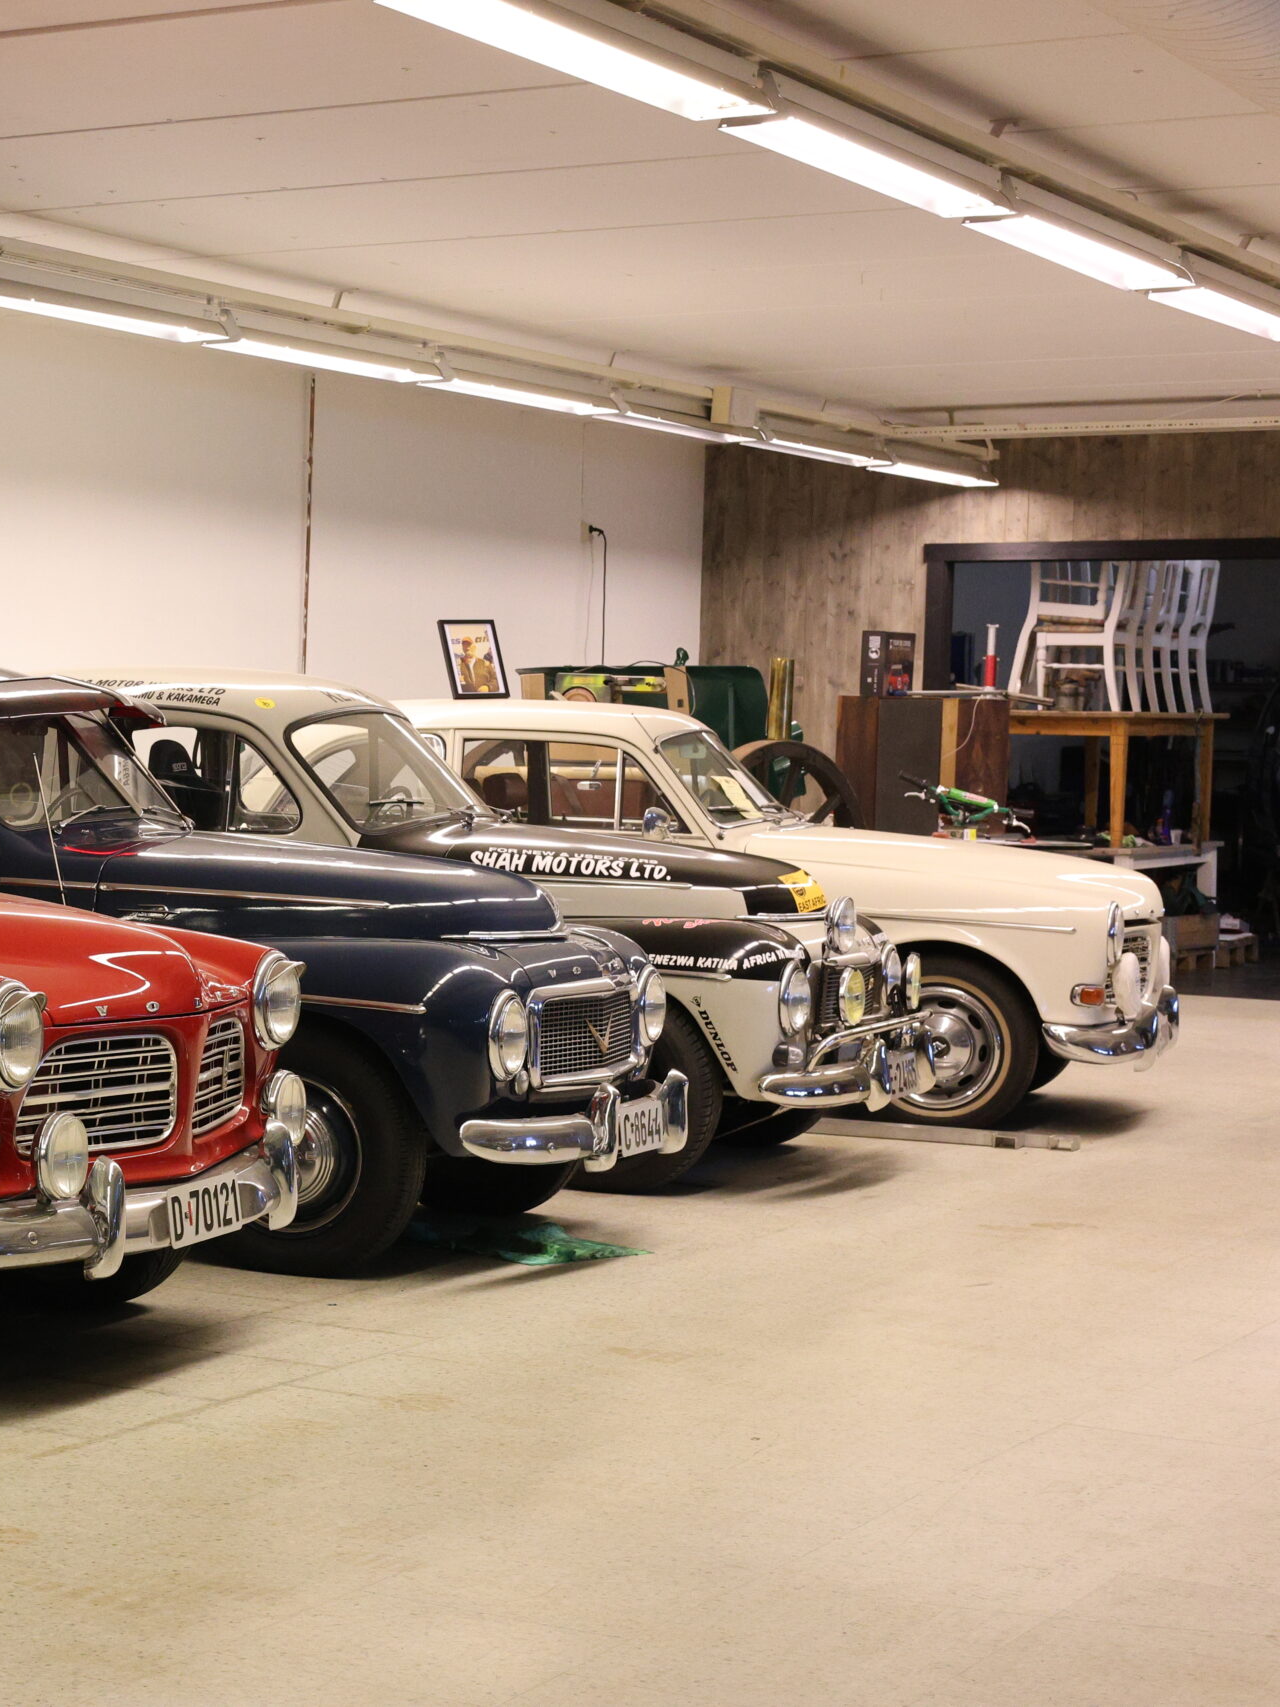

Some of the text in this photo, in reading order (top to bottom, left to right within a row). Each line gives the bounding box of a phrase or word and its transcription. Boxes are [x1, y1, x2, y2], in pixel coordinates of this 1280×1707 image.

[95, 679, 145, 688] MOTOR
[198, 687, 227, 696] LTD
[156, 691, 163, 700] &
[166, 692, 220, 707] KAKAMEGA
[470, 850, 671, 881] SHAH MOTORS LTD.
[522, 849, 556, 857] NEW
[569, 853, 614, 861] USED
[618, 857, 659, 865] CARS
[798, 900, 812, 913] EAST
[648, 953, 694, 967] ENEZWA
[696, 956, 739, 971] KATIKA
[742, 951, 778, 970] AFRICA
[698, 1009, 739, 1073] DUNLOP
